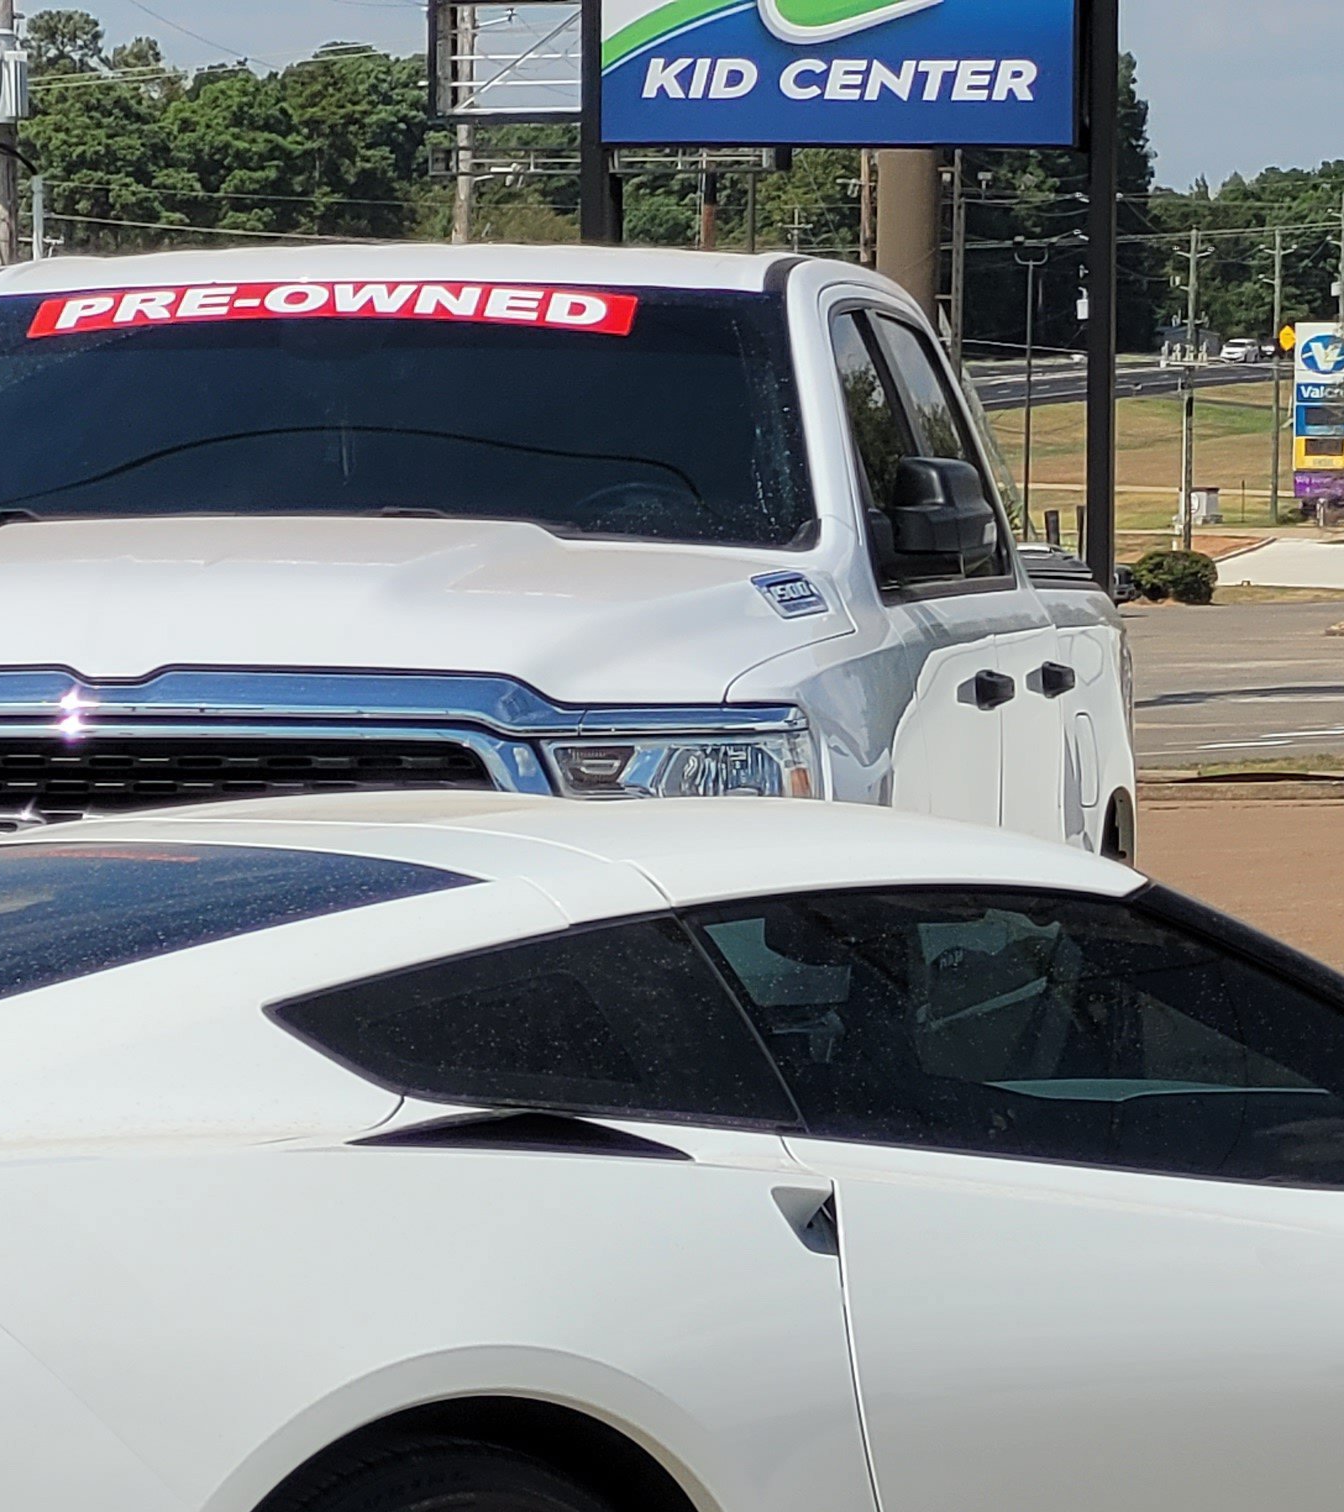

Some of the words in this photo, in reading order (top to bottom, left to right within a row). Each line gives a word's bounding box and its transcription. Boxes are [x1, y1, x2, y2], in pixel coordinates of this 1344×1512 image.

[641, 58, 758, 99] KID
[778, 58, 1038, 102] CENTER
[55, 284, 607, 329] PRE-OWNED
